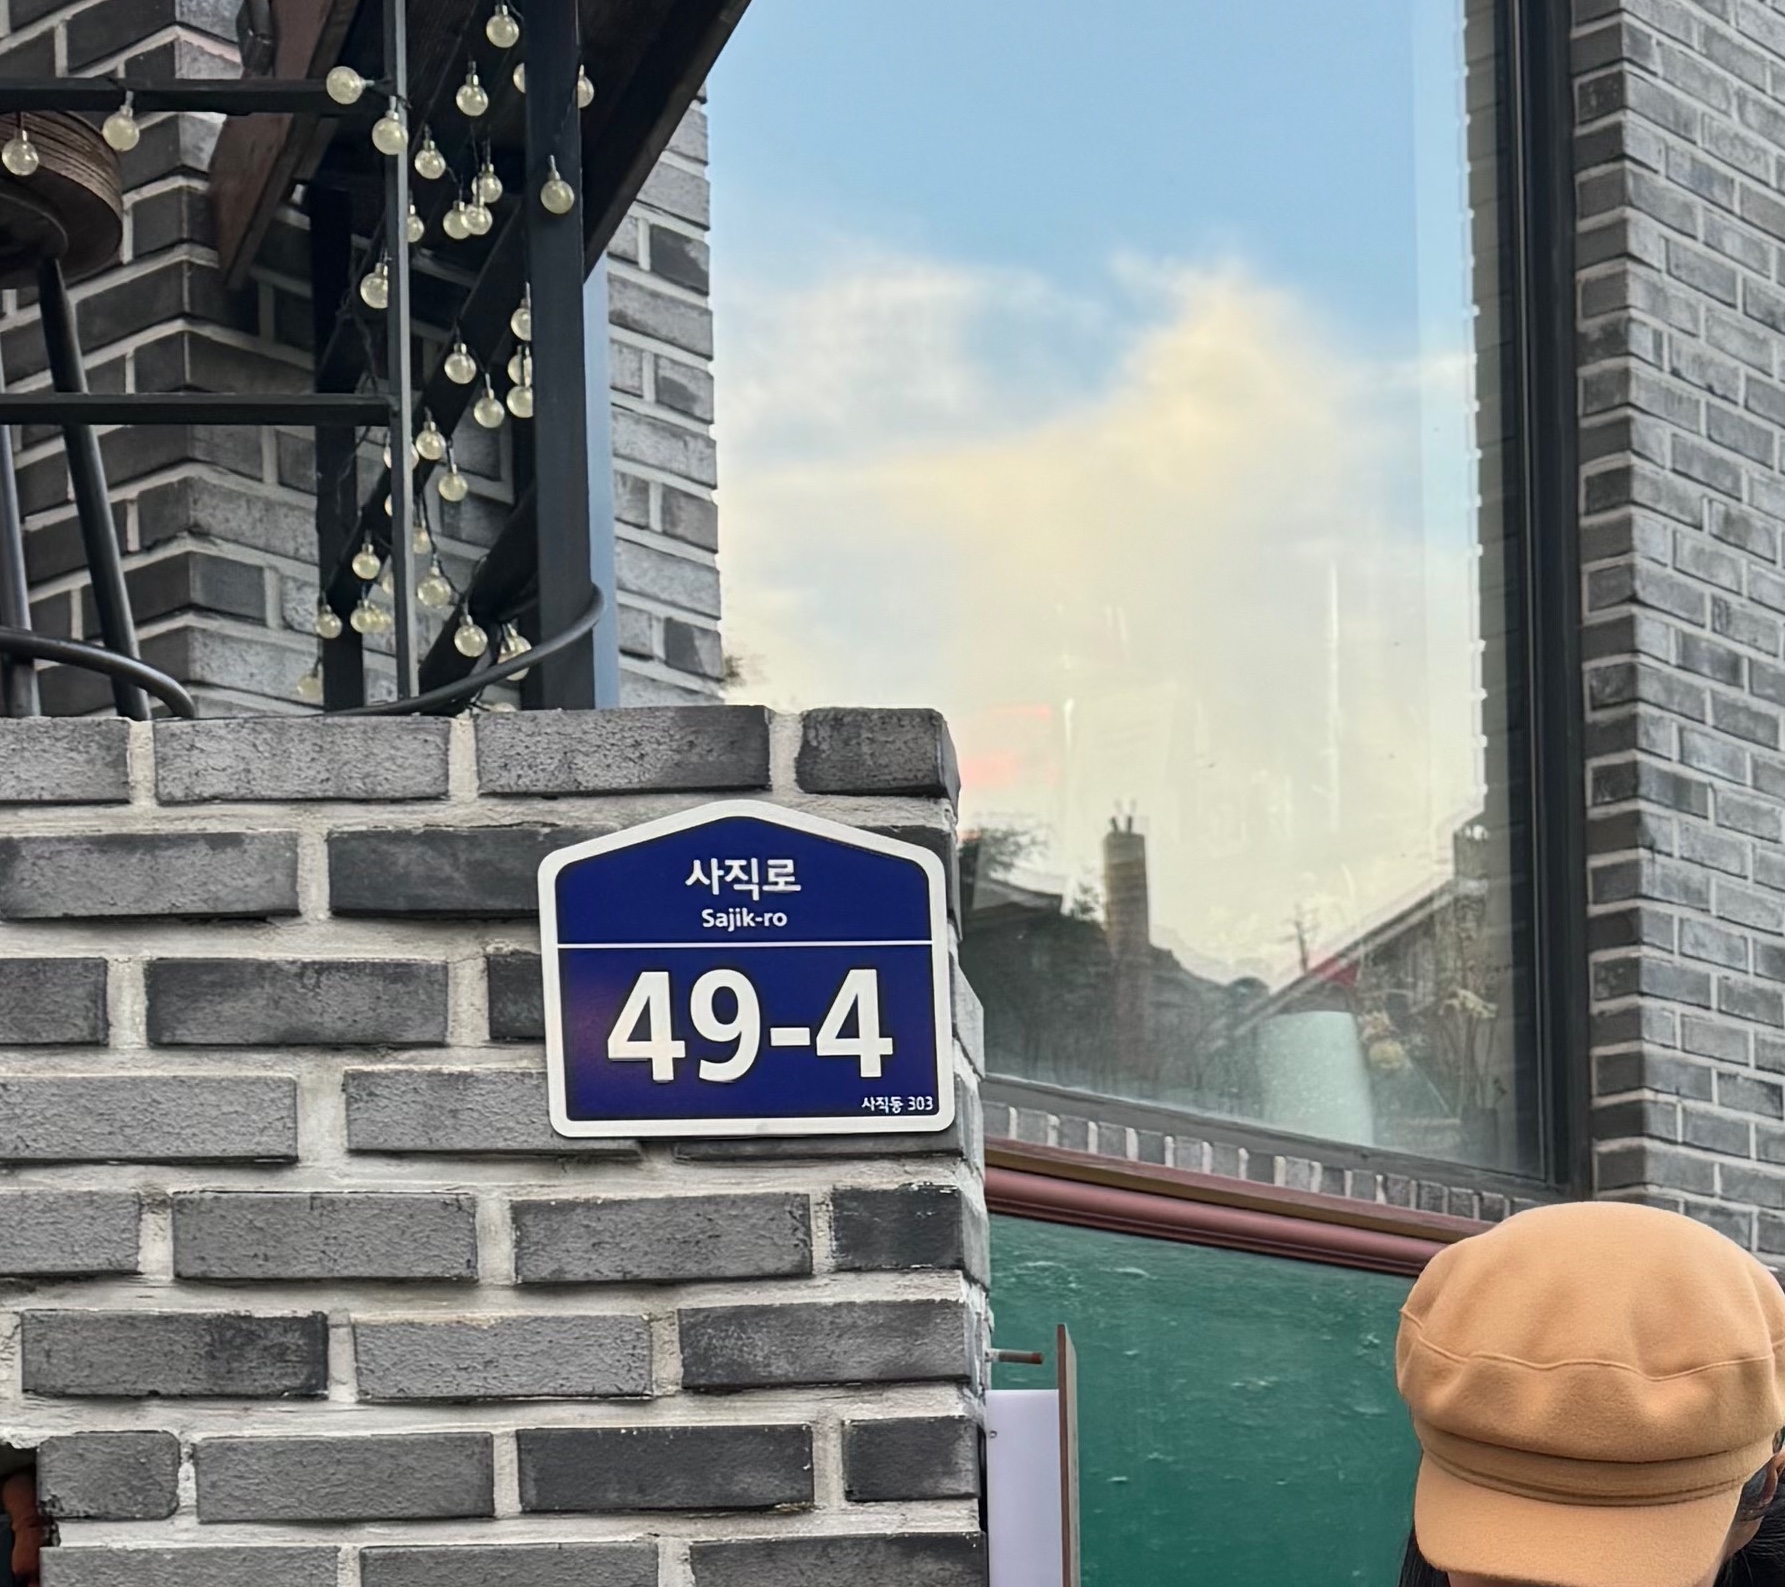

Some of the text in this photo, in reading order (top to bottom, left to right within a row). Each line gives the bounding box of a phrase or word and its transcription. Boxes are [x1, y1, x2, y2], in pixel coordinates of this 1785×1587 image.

[685, 857, 802, 901] 사직로
[701, 907, 788, 932] Sajik-ro
[607, 968, 894, 1082] 49-4
[861, 1095, 934, 1114] 사직동 303
